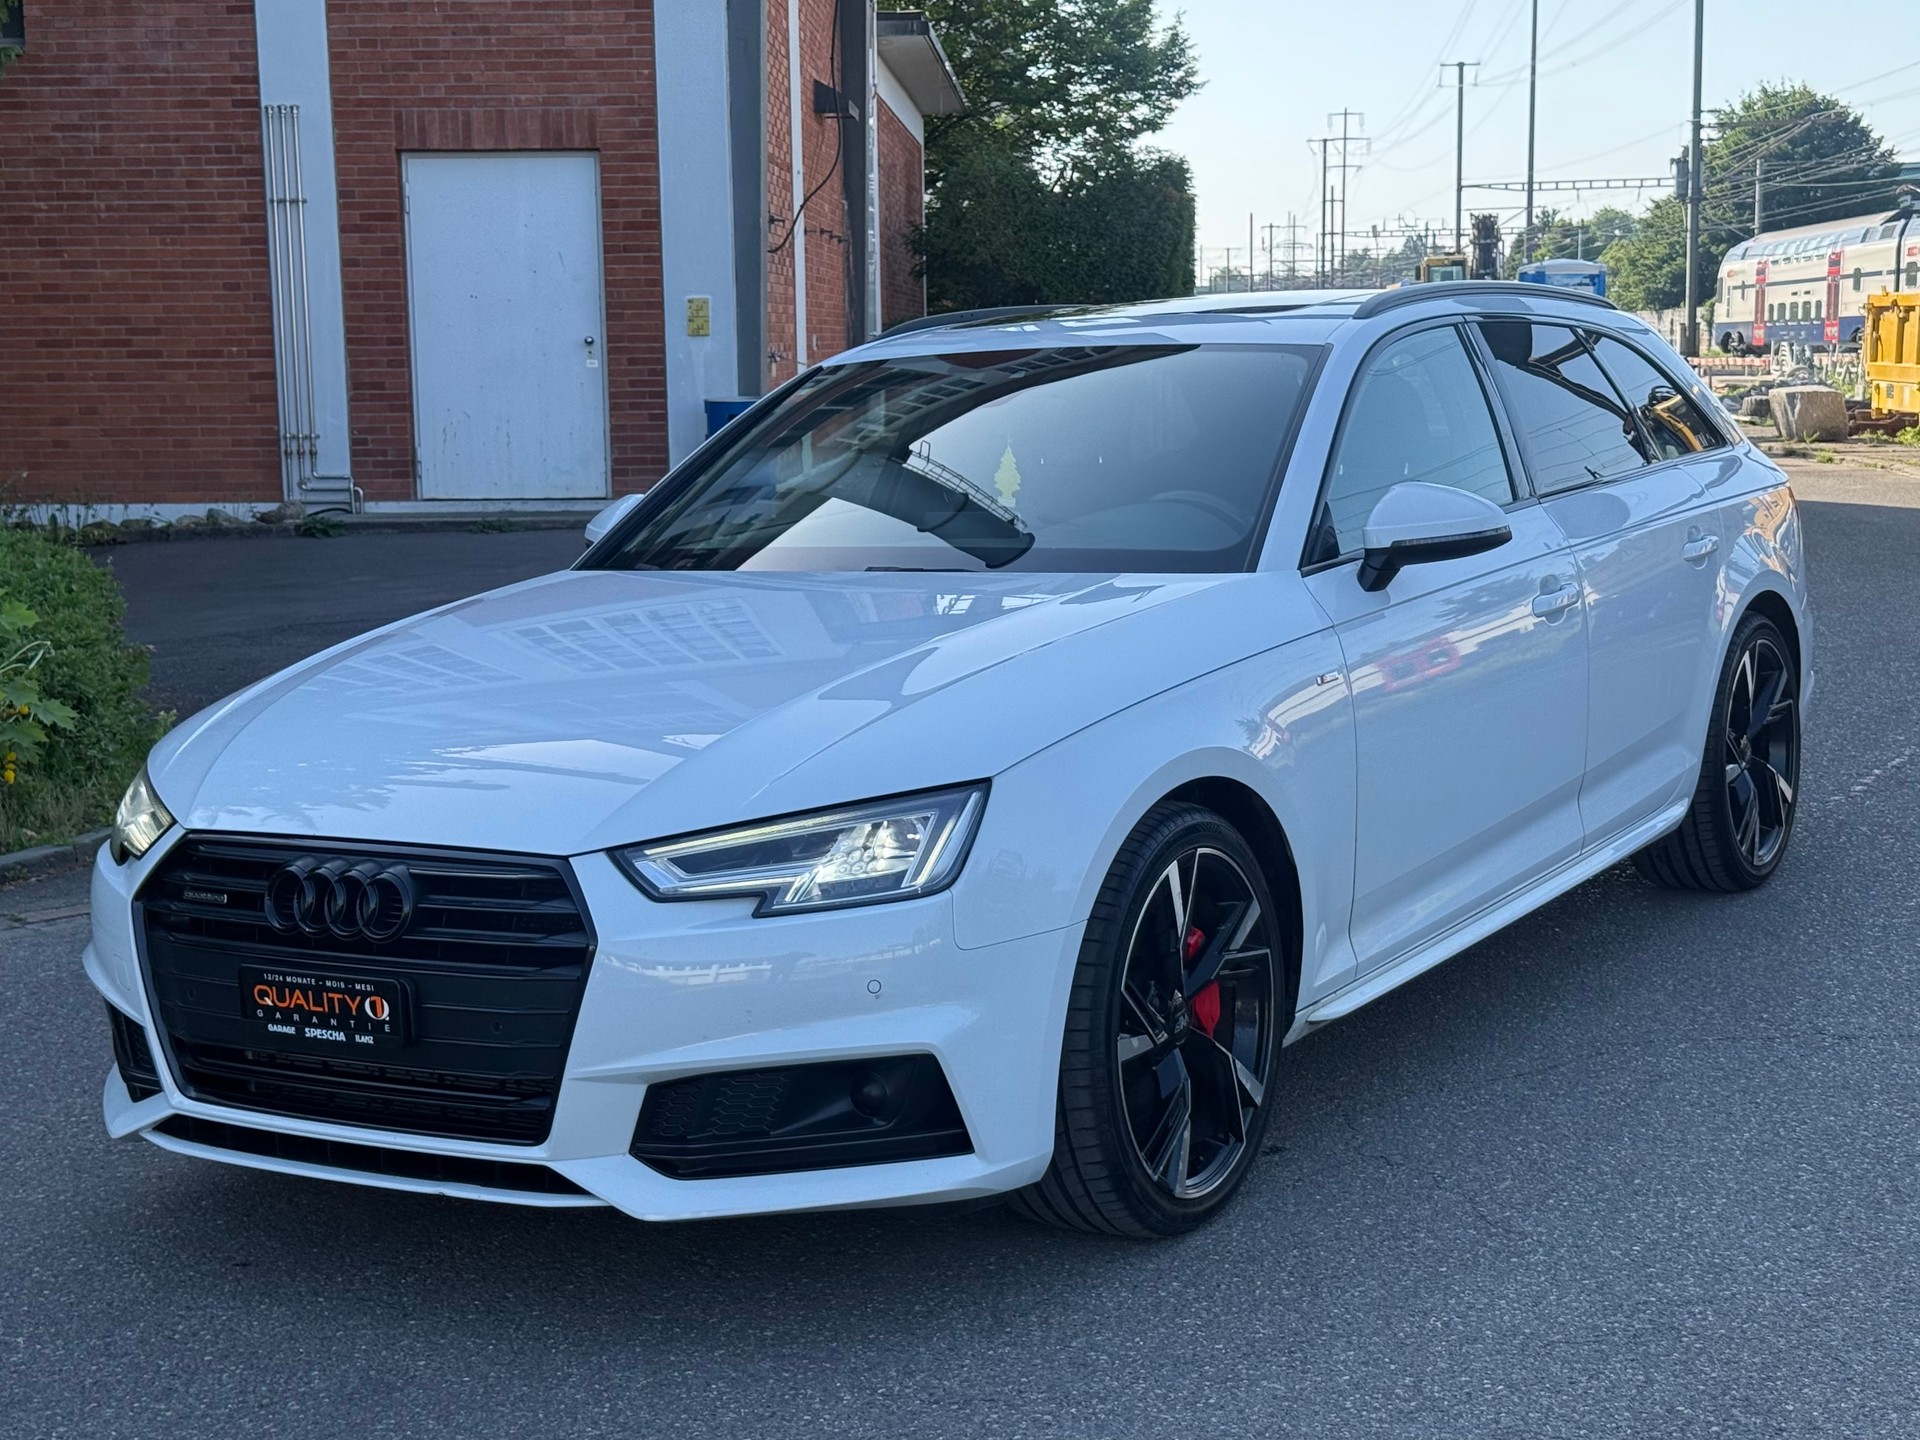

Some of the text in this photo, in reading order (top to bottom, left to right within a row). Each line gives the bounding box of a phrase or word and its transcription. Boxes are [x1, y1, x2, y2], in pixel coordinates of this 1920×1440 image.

[263, 973, 283, 982] 12/24
[286, 975, 316, 986] MONATE
[325, 979, 345, 989] MOIS
[355, 983, 375, 992] MESI
[253, 984, 361, 1016] QUALITY
[267, 1023, 375, 1044] GARAGE SPESCHA ILANZ
